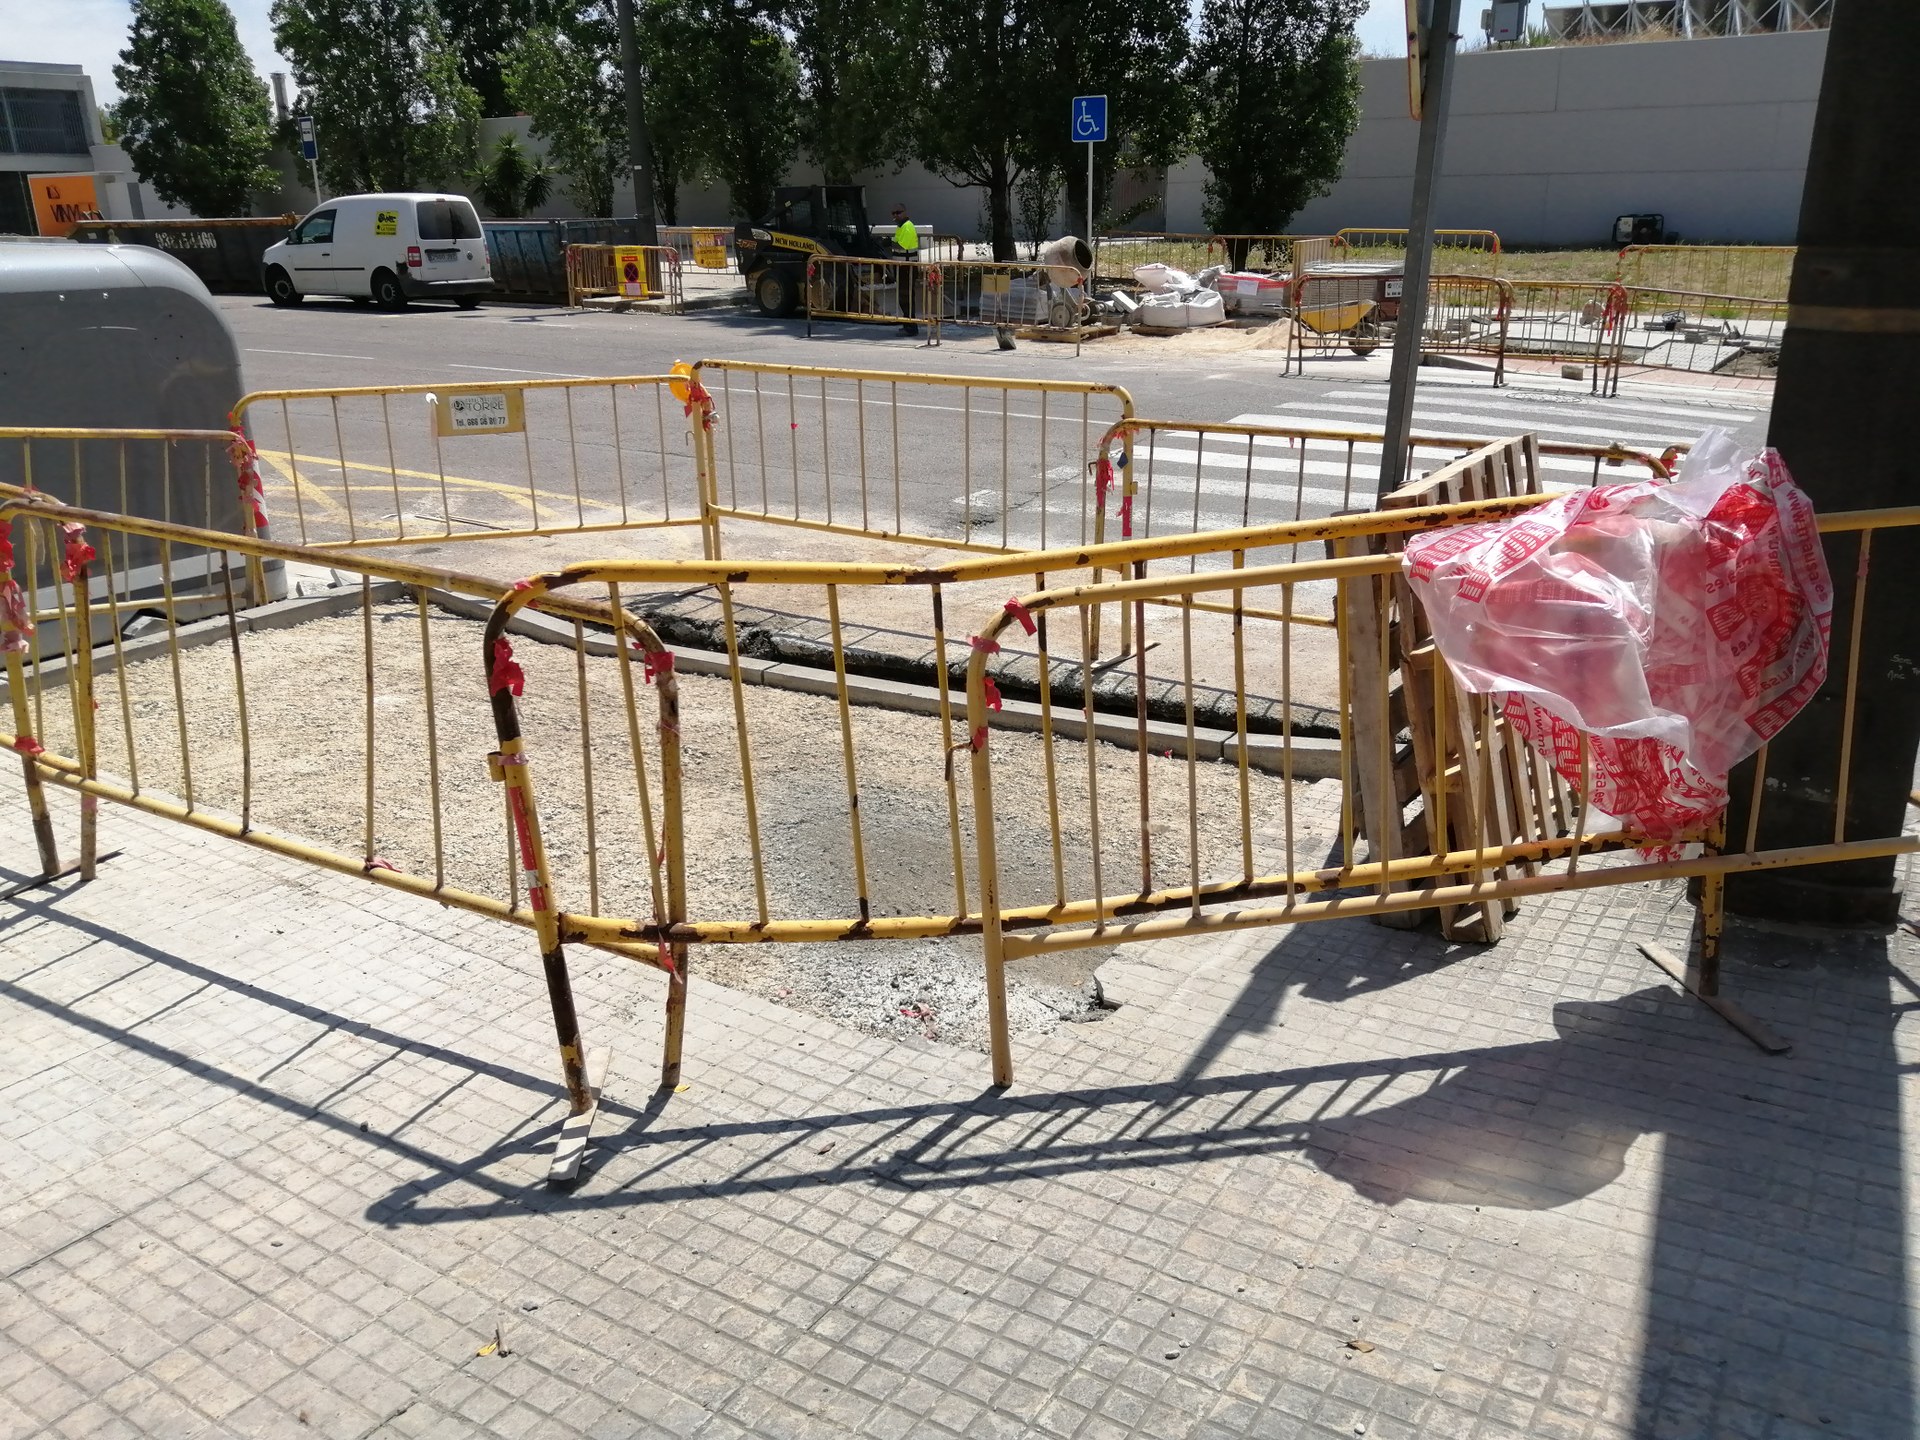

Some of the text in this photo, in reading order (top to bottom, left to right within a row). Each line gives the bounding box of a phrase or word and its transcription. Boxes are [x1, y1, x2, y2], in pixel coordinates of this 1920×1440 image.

[775, 238, 815, 251] NEW HOLLAND
[466, 401, 505, 412] TORRE
